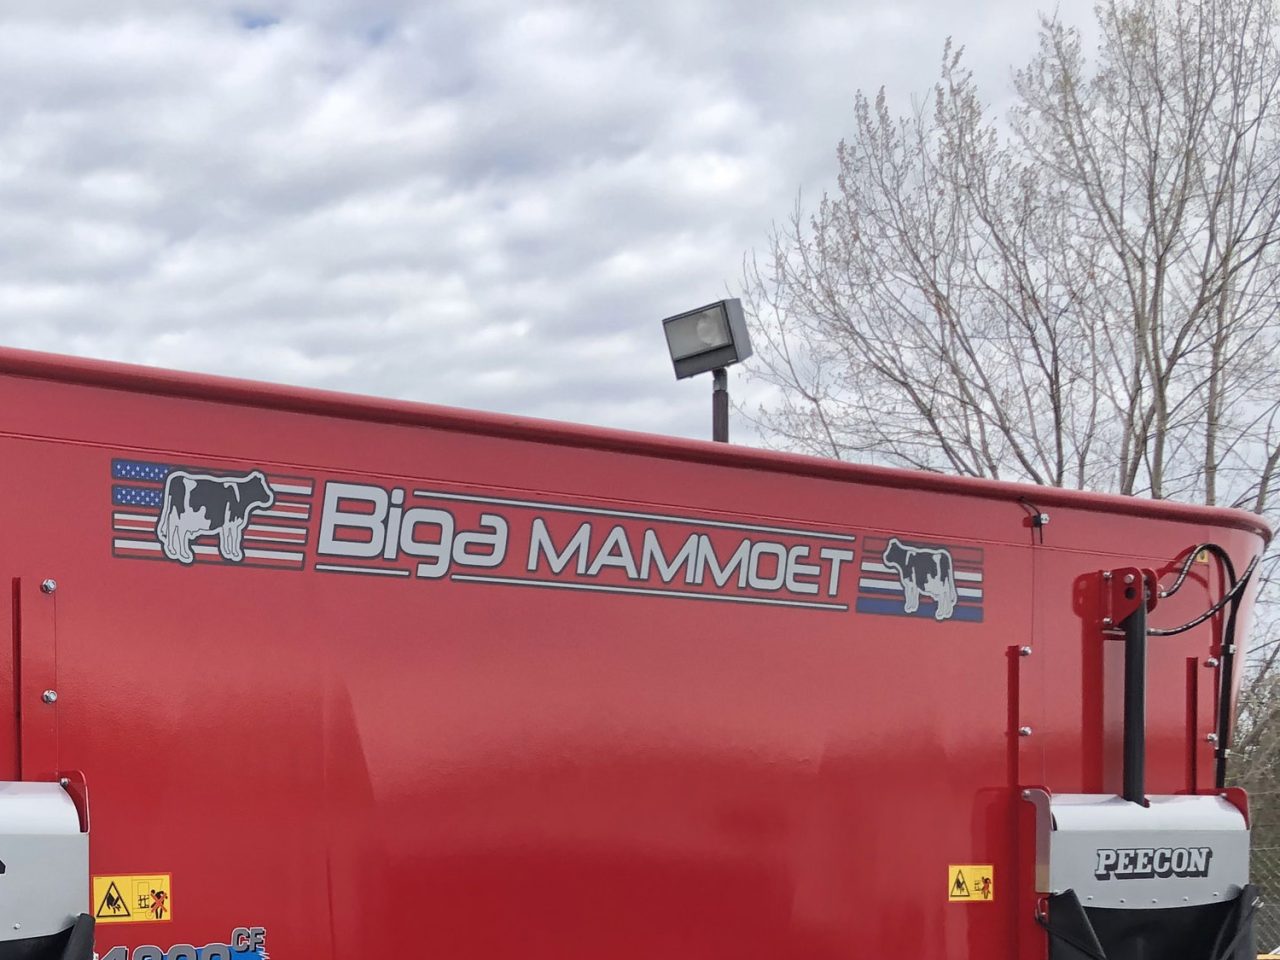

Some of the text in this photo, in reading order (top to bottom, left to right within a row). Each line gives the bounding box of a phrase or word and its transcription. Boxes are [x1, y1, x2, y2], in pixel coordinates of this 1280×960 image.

[317, 482, 855, 598] Biga MAMMOET
[1095, 846, 1213, 880] PEECON
[232, 927, 267, 952] CF
